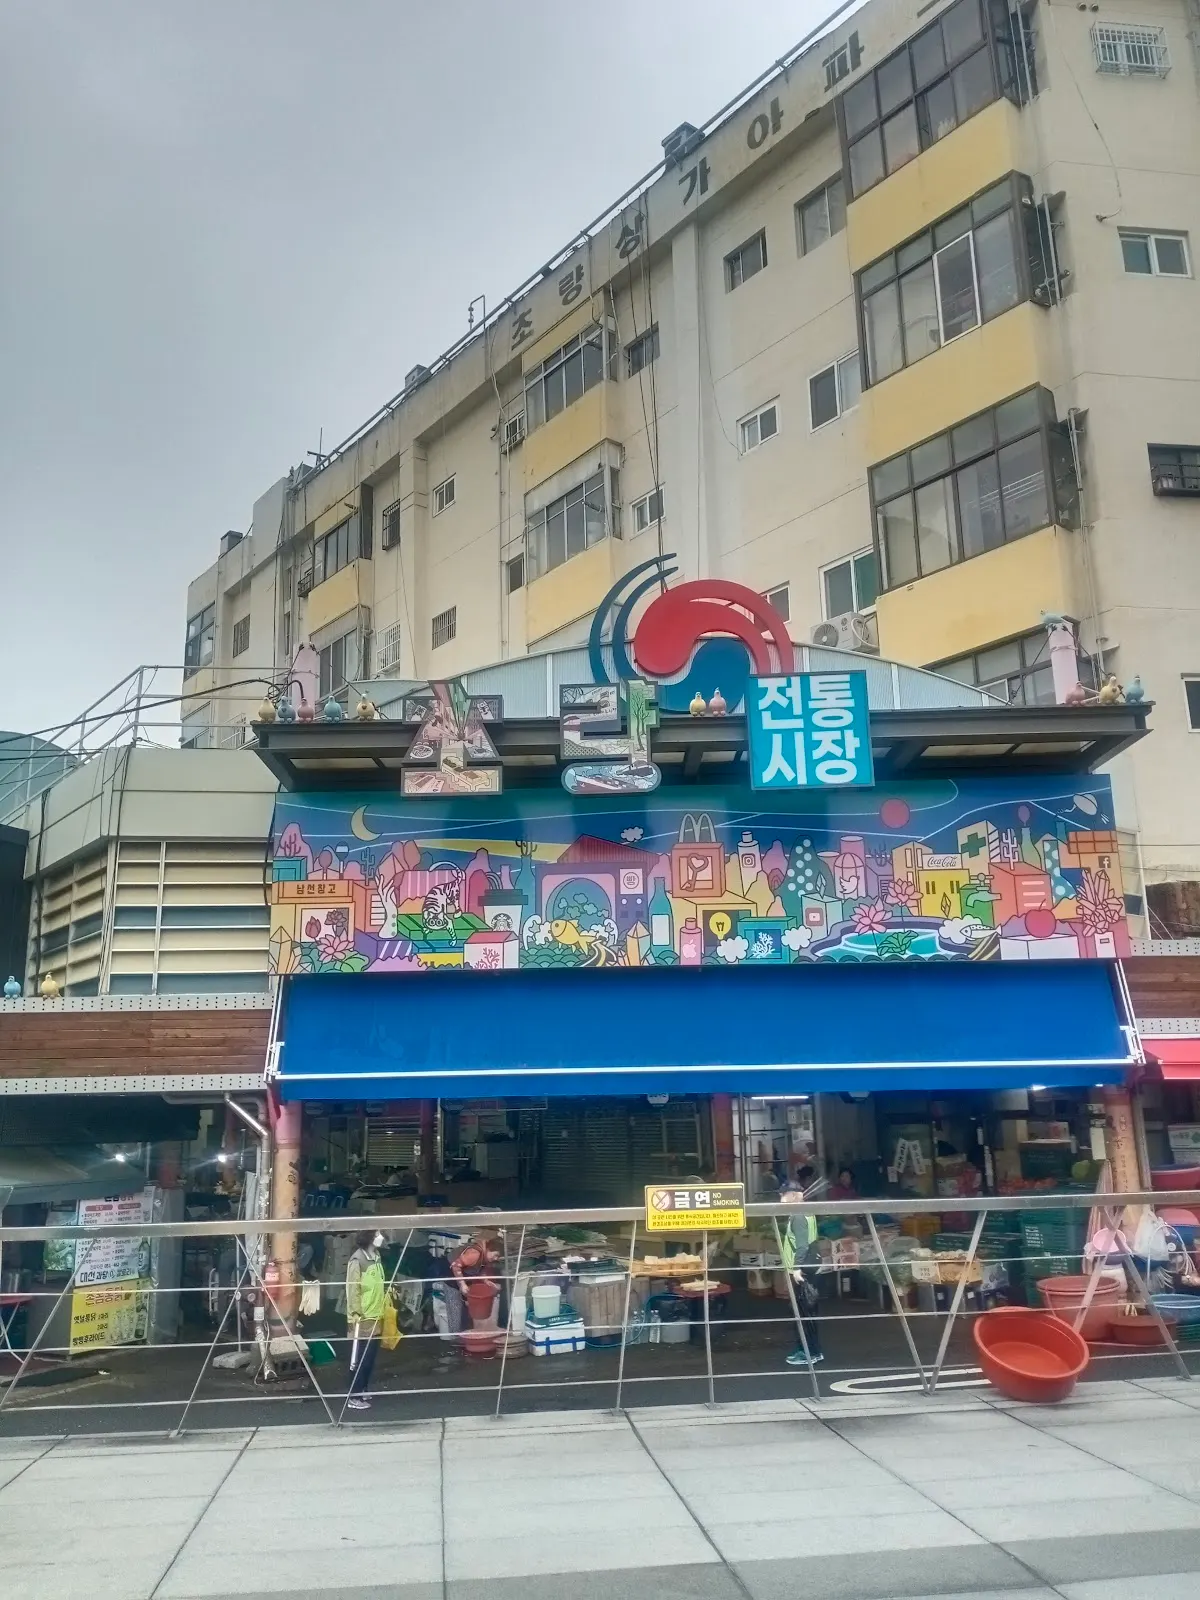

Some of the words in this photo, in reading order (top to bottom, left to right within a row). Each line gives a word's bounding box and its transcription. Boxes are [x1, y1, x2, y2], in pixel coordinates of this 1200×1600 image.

[758, 675, 856, 731] 전통
[761, 730, 859, 785] 시장
[674, 1190, 711, 1209] 금연
